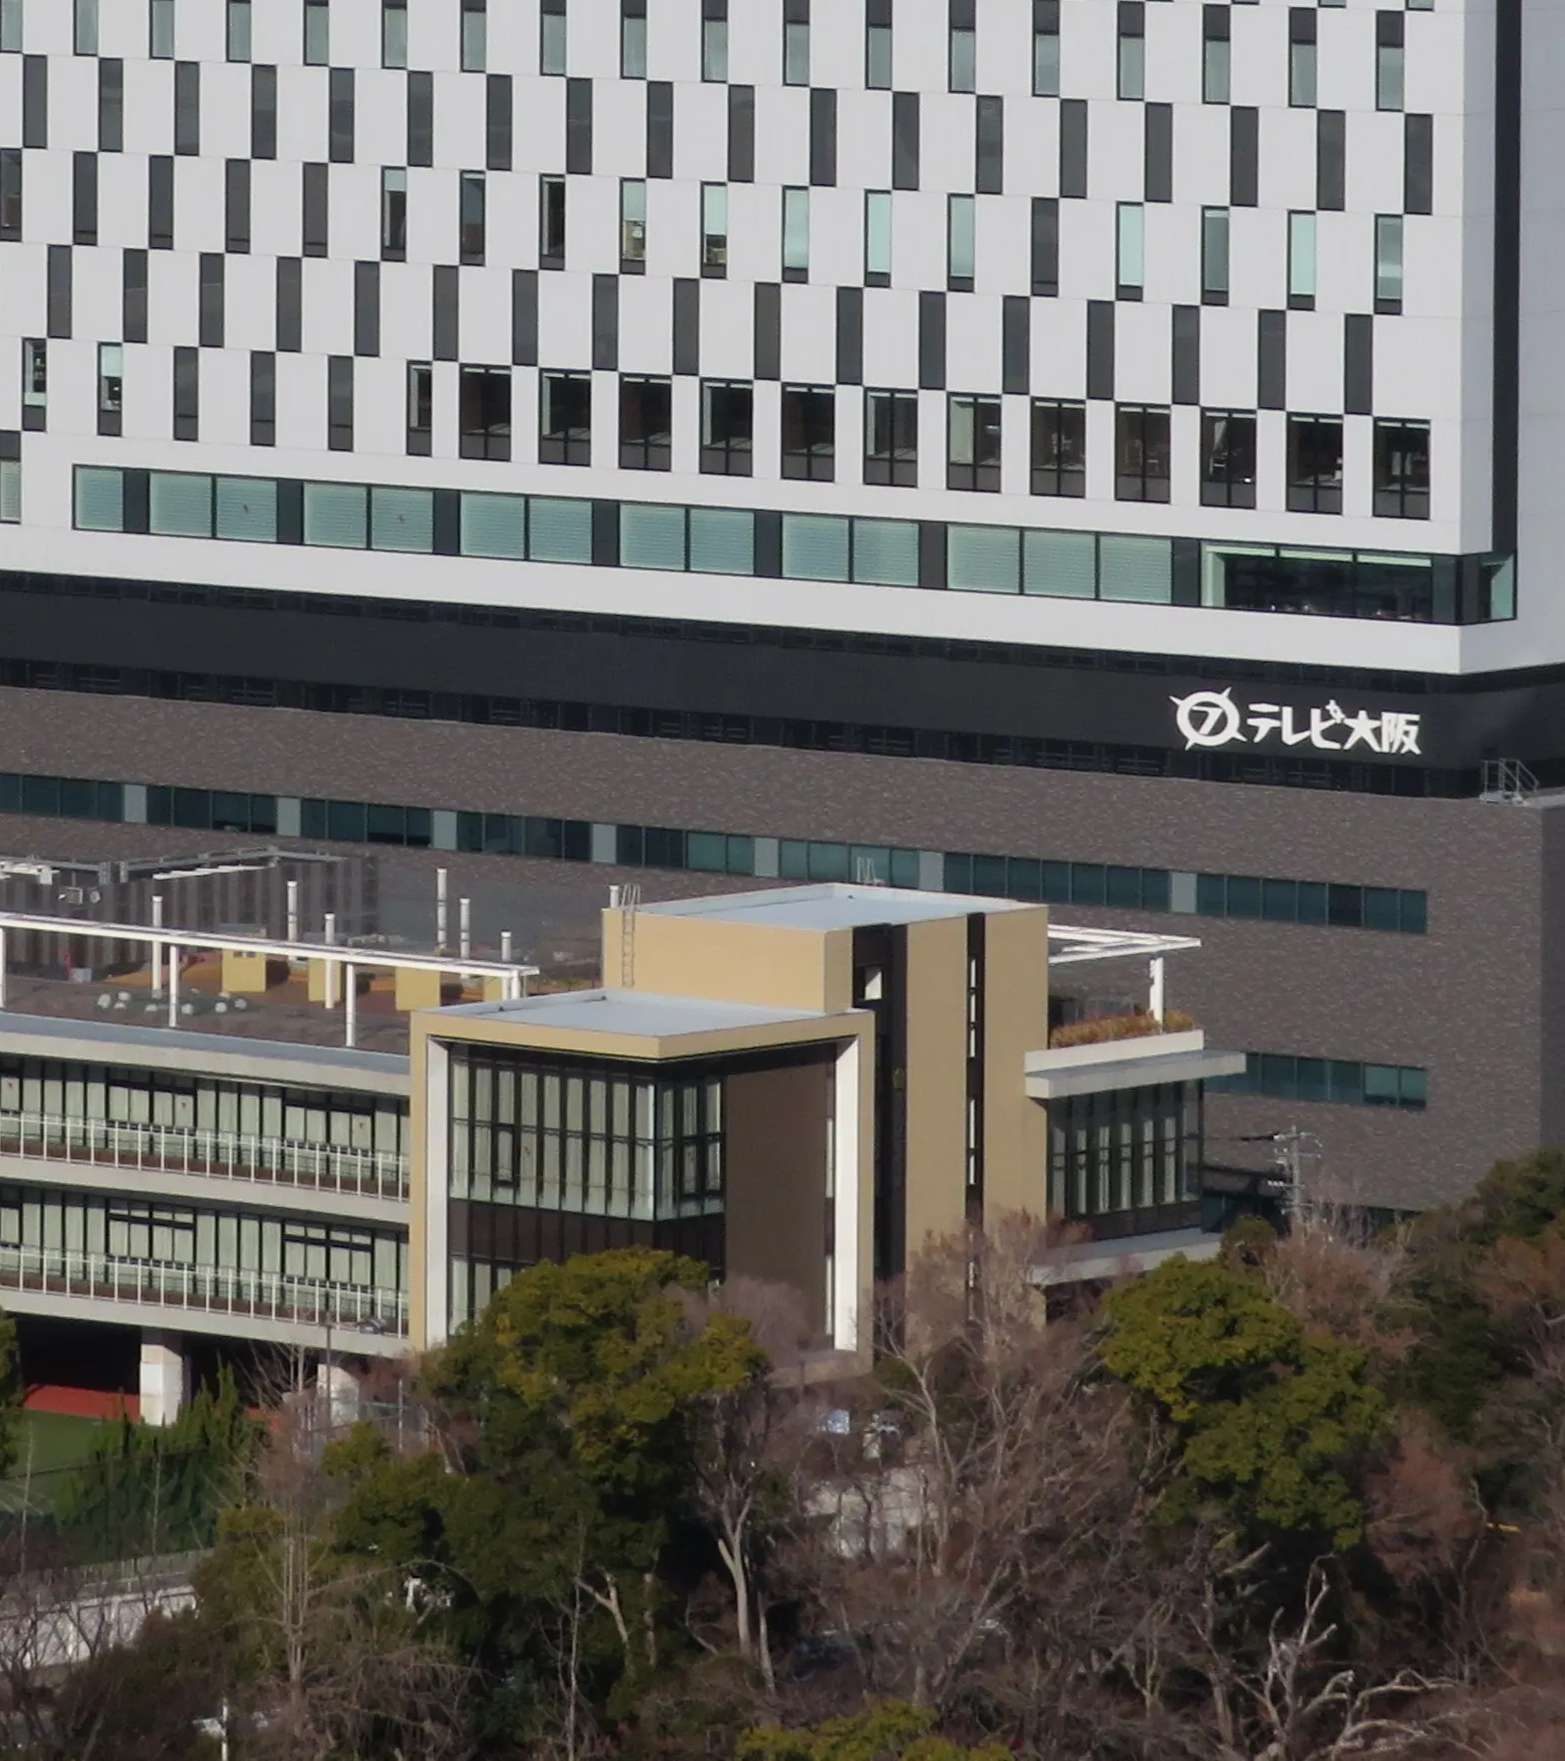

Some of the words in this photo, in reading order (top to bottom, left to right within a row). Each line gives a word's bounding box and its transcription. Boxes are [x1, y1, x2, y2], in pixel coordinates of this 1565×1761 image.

[1247, 699, 1422, 755] テレビ大阪
